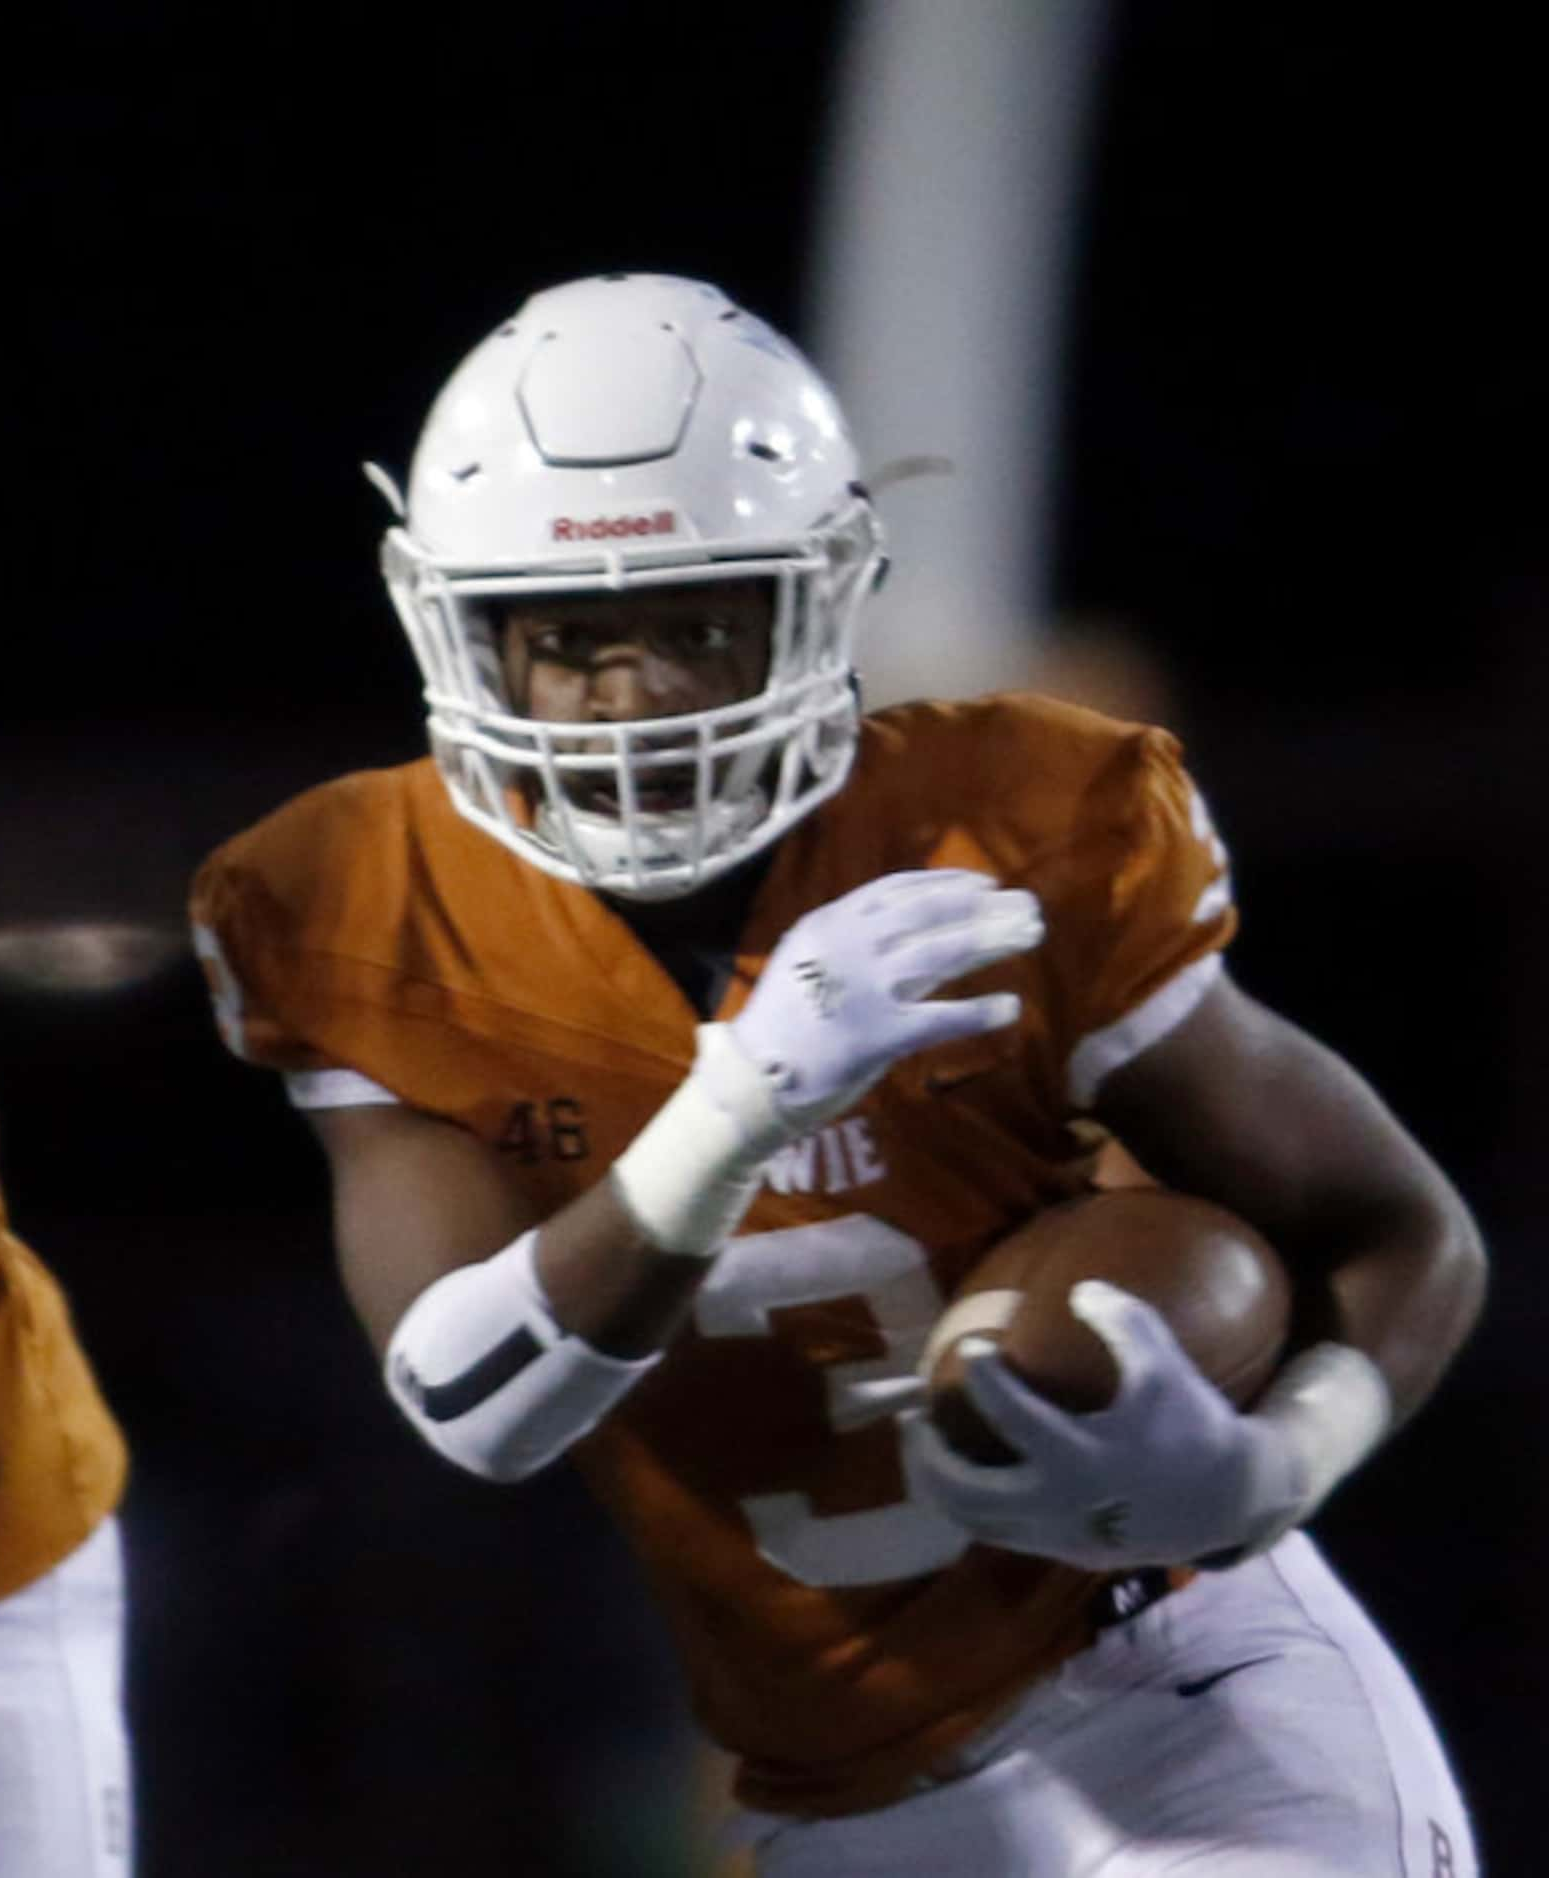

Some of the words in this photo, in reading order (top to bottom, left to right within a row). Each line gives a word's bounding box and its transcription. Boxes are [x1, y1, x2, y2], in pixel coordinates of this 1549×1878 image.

[551, 510, 676, 542] Riddell
[494, 1097, 590, 1168] 46
[694, 1211, 974, 1588] 3
